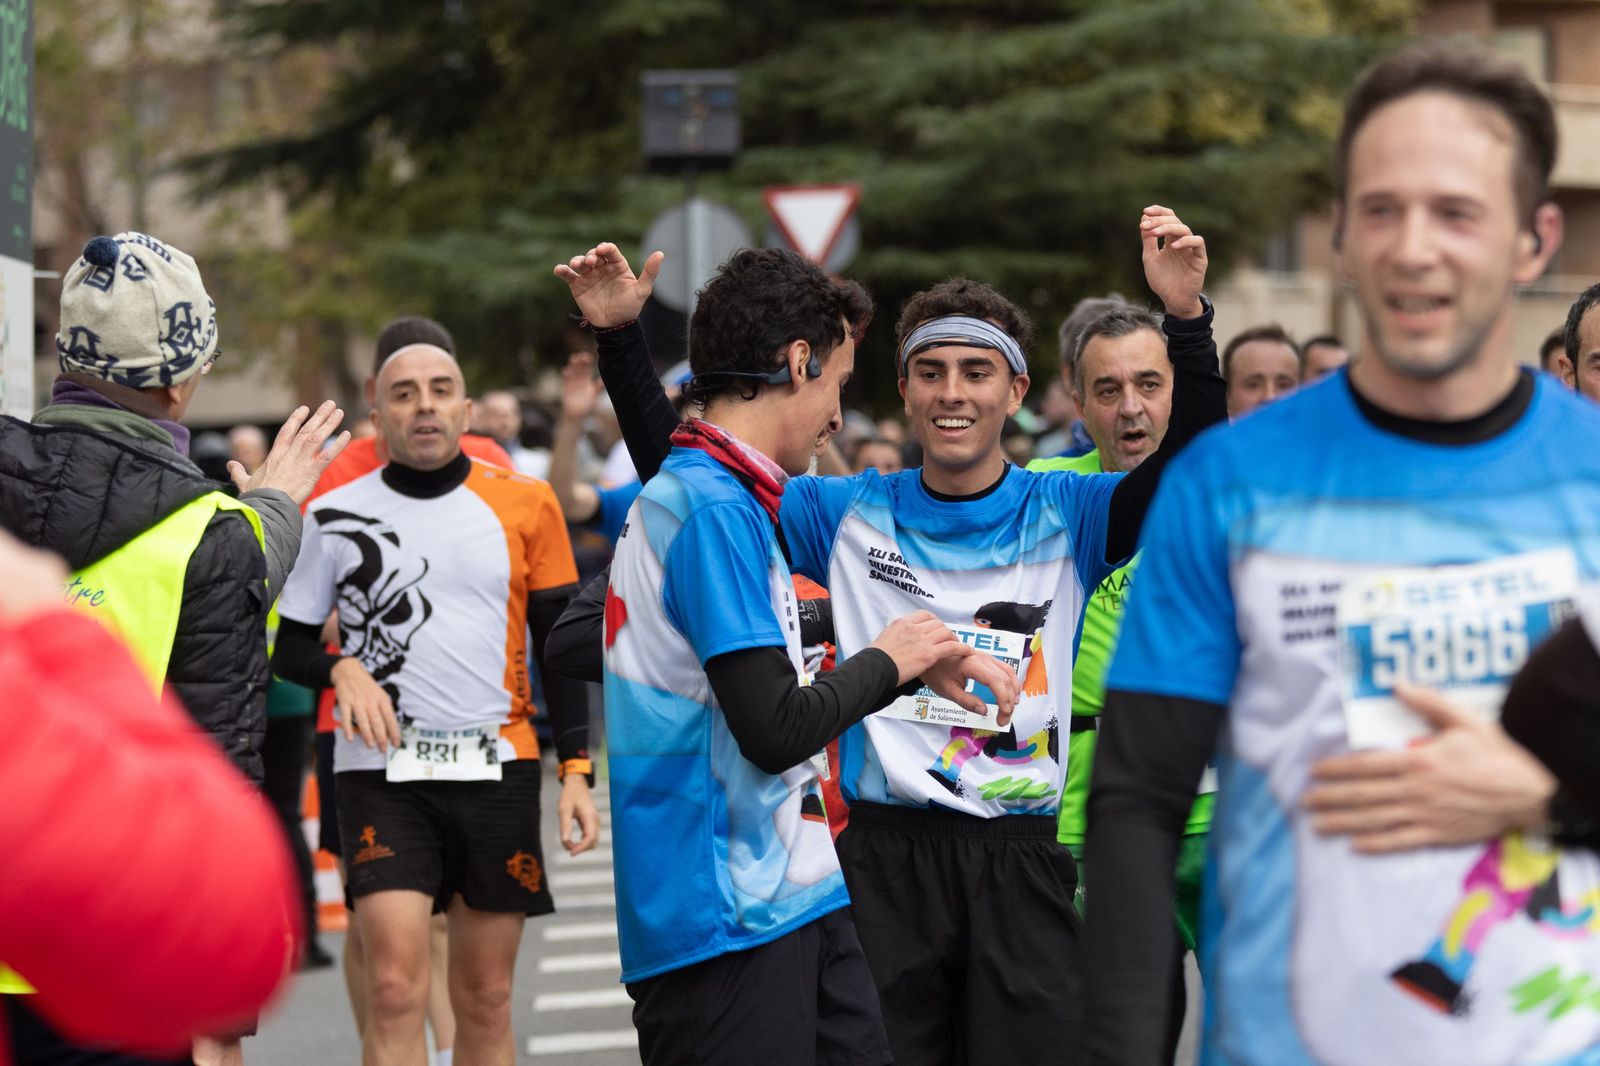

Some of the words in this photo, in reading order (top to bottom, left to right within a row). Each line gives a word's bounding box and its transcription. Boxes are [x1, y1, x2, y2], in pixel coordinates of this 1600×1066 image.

[868, 546, 887, 559] XLI
[951, 629, 1008, 652] TEL
[1371, 609, 1528, 689] 5866
[930, 705, 968, 716] Ayuntamiento
[937, 714, 967, 724] Salamanca
